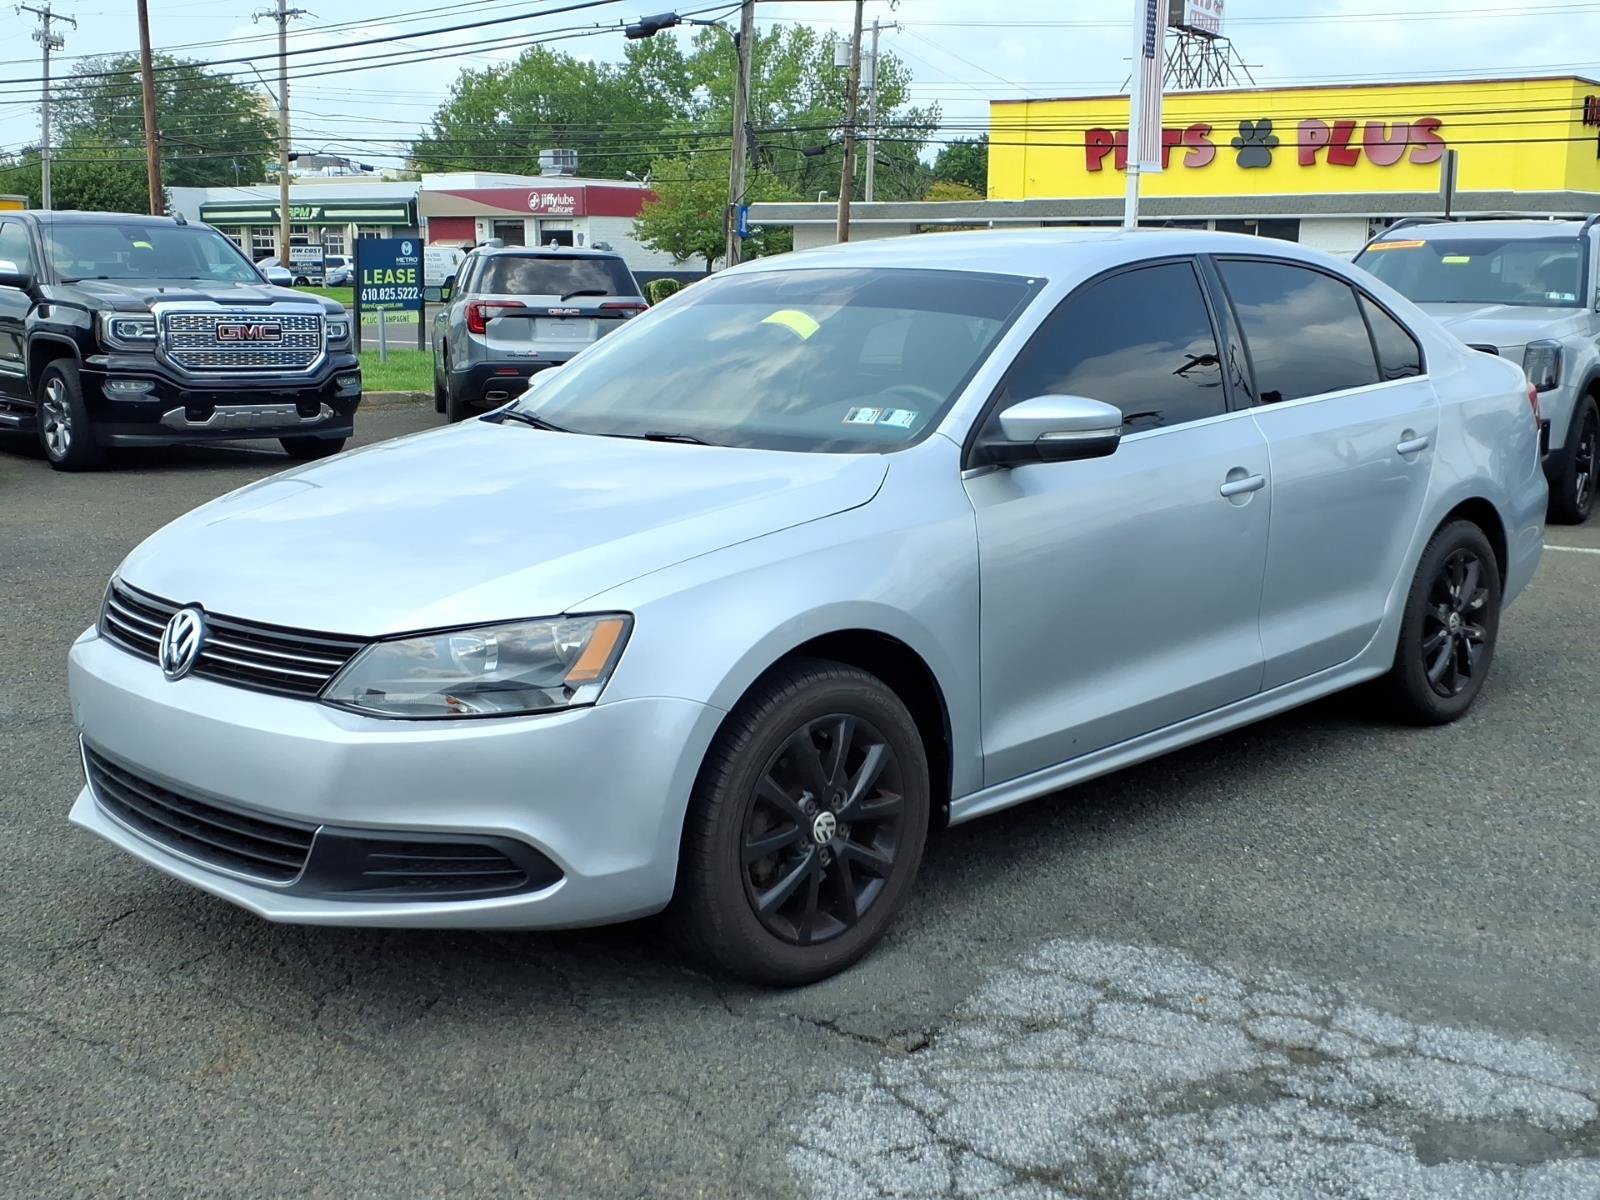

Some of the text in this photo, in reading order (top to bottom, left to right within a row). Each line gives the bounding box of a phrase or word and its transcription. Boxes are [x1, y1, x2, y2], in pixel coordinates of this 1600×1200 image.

[1298, 118, 1446, 167] PLUS
[364, 268, 416, 285] LEASE
[361, 287, 418, 301] 610.825.5222
[218, 324, 280, 340] GMC
